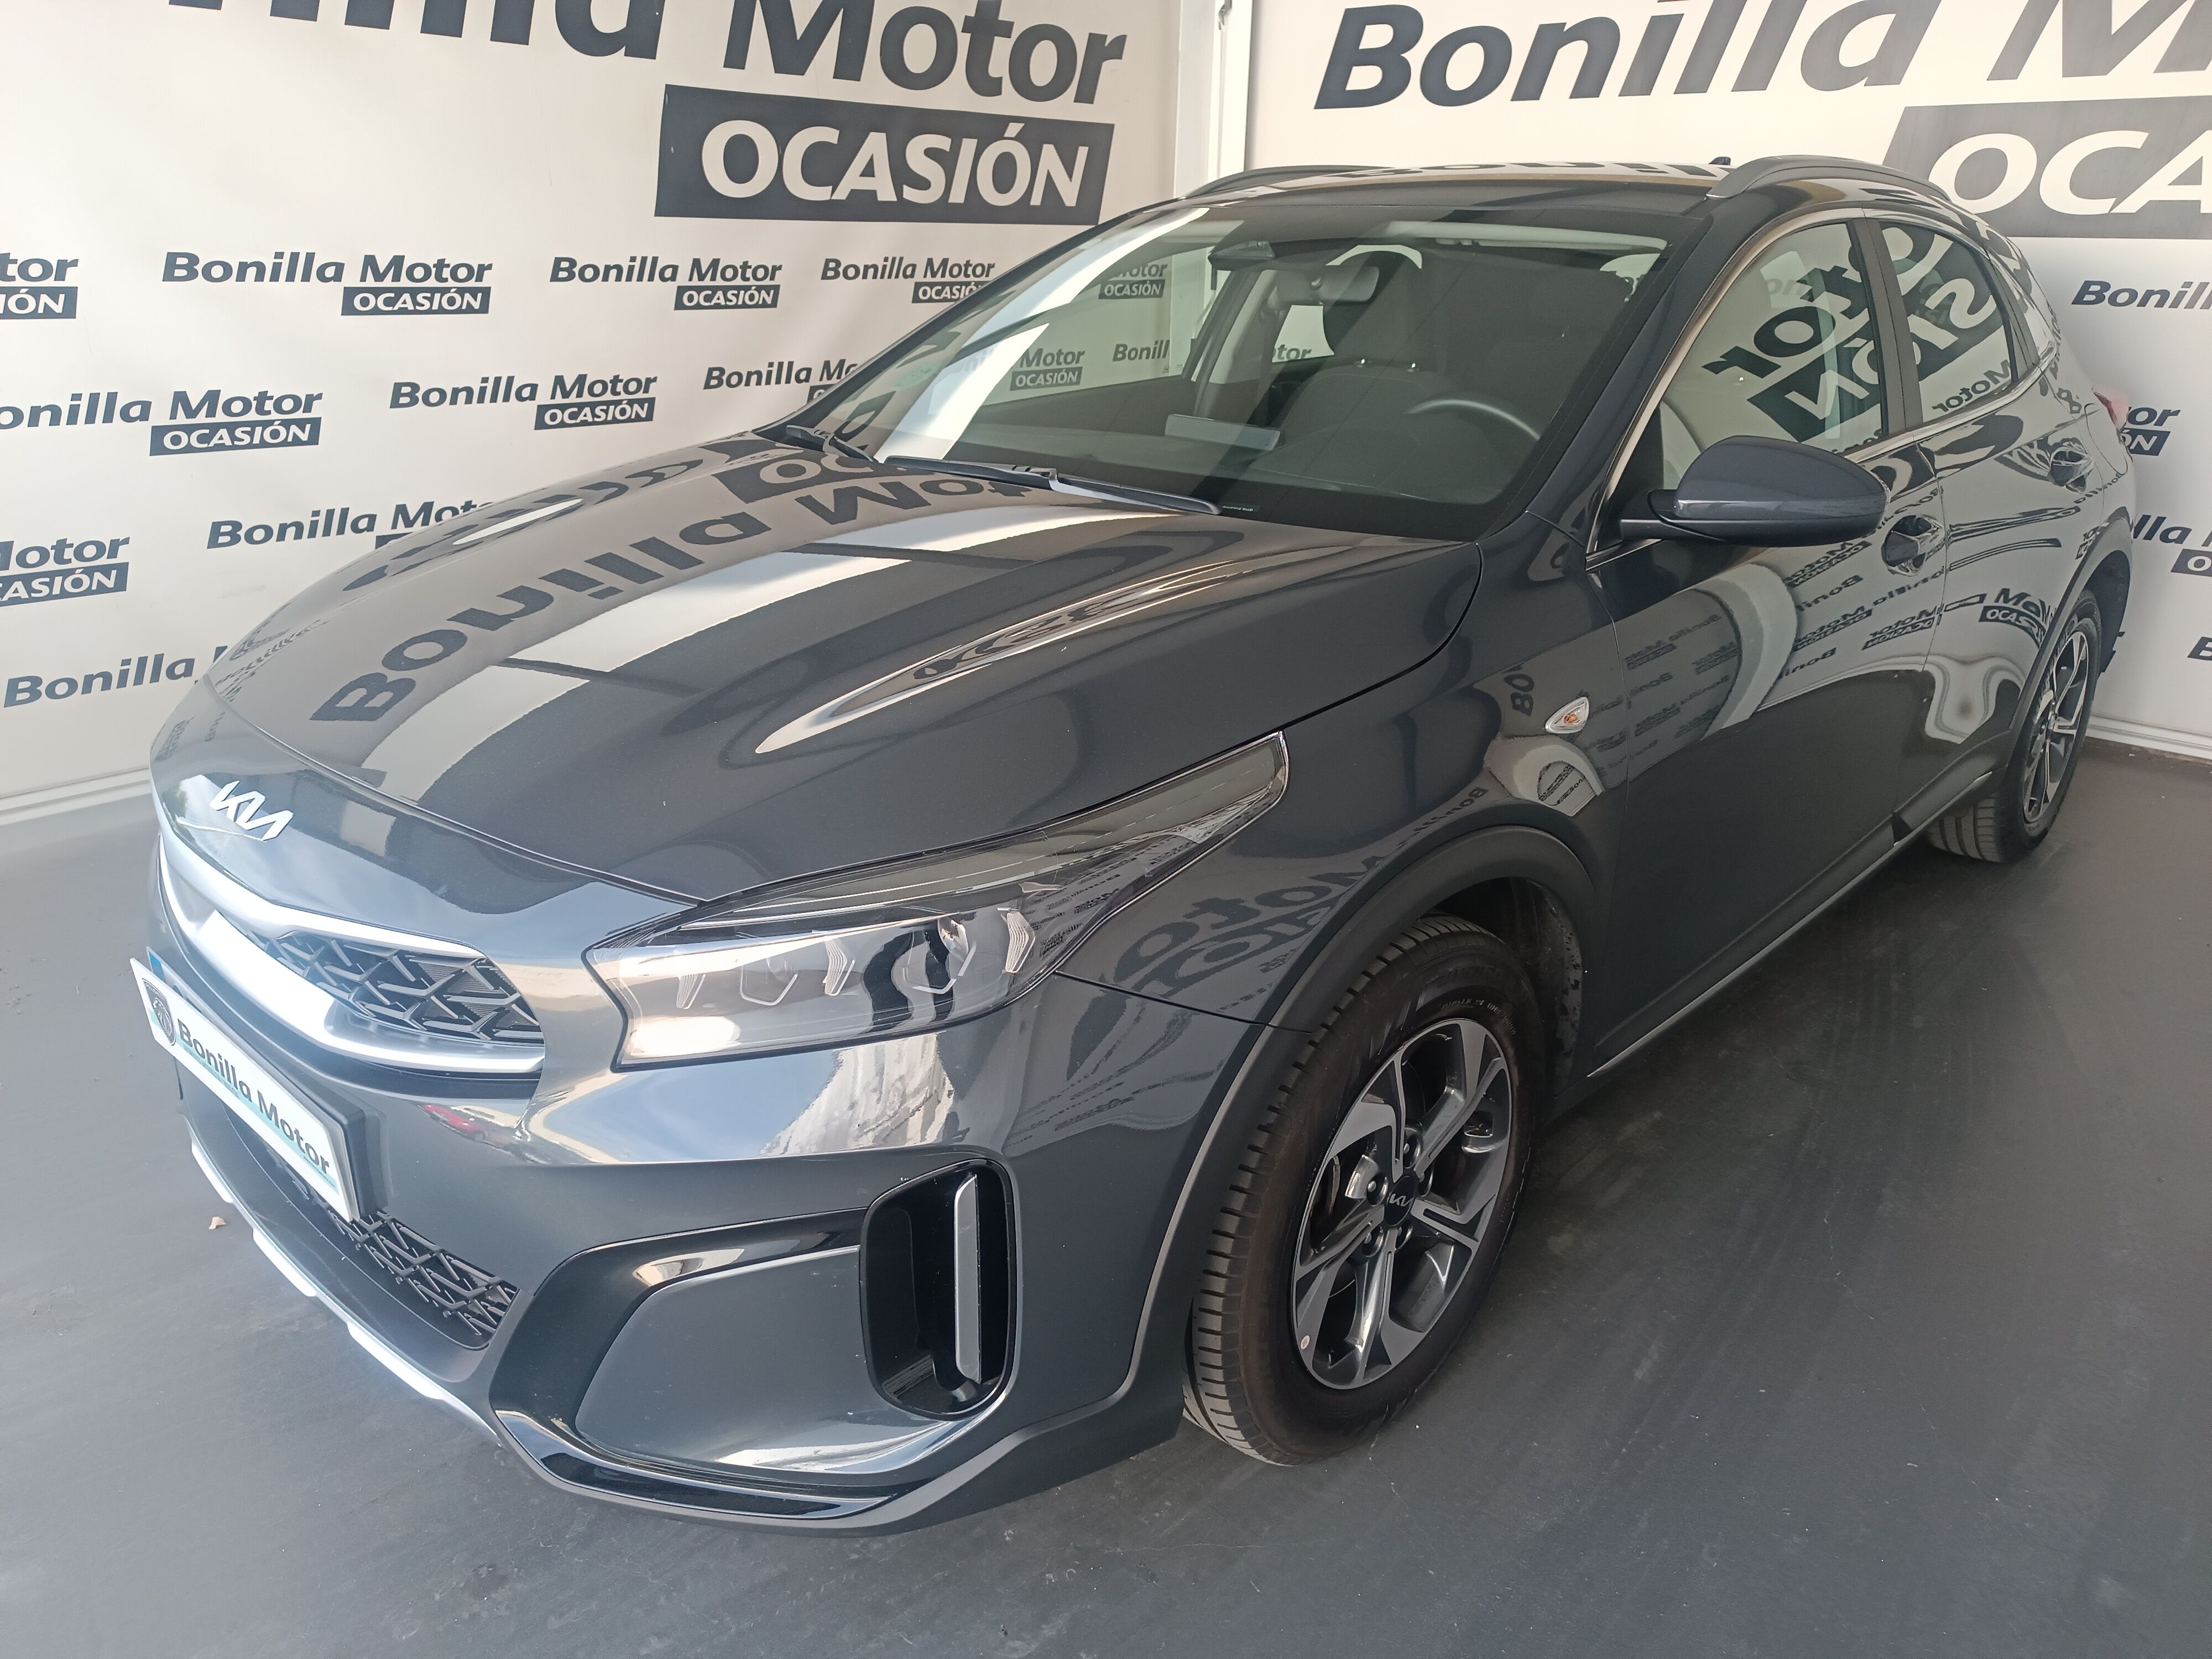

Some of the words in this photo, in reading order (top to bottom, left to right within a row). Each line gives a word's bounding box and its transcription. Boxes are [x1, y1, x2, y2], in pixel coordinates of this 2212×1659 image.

[723, 0, 1127, 104] Motor
[1314, 0, 1942, 109] Bonilla
[701, 122, 1088, 206] OCASIÓN
[163, 252, 345, 283] Bonilla
[360, 255, 493, 283] Motor
[550, 256, 679, 283] Bonilla
[688, 258, 782, 281] Motor
[821, 257, 917, 280] Bonilla
[924, 258, 995, 278] Motor
[354, 289, 482, 311] OCASIÓN
[682, 286, 774, 307] OCASIÓN
[919, 282, 982, 300] OCASIÓ
[1104, 281, 1161, 296] OCASIÓN
[1020, 348, 1084, 368] Motor
[1274, 344, 1312, 360] tor
[703, 361, 812, 389] Bonilla
[1016, 369, 1078, 387] OCASIÓN
[169, 390, 322, 420] Motor
[390, 376, 539, 408] Bonilla
[550, 374, 658, 400] Motor
[544, 400, 648, 425] OCASIÓN
[2127, 407, 2180, 426] or
[163, 421, 311, 450] OCASIÓN
[207, 507, 377, 549] Bonilla
[391, 499, 494, 530] Mot
[0, 568, 117, 603] ASIÓN
[4, 653, 195, 708] Bonilla
[178, 1018, 252, 1102] Bonilla
[257, 1089, 330, 1173] Motor
